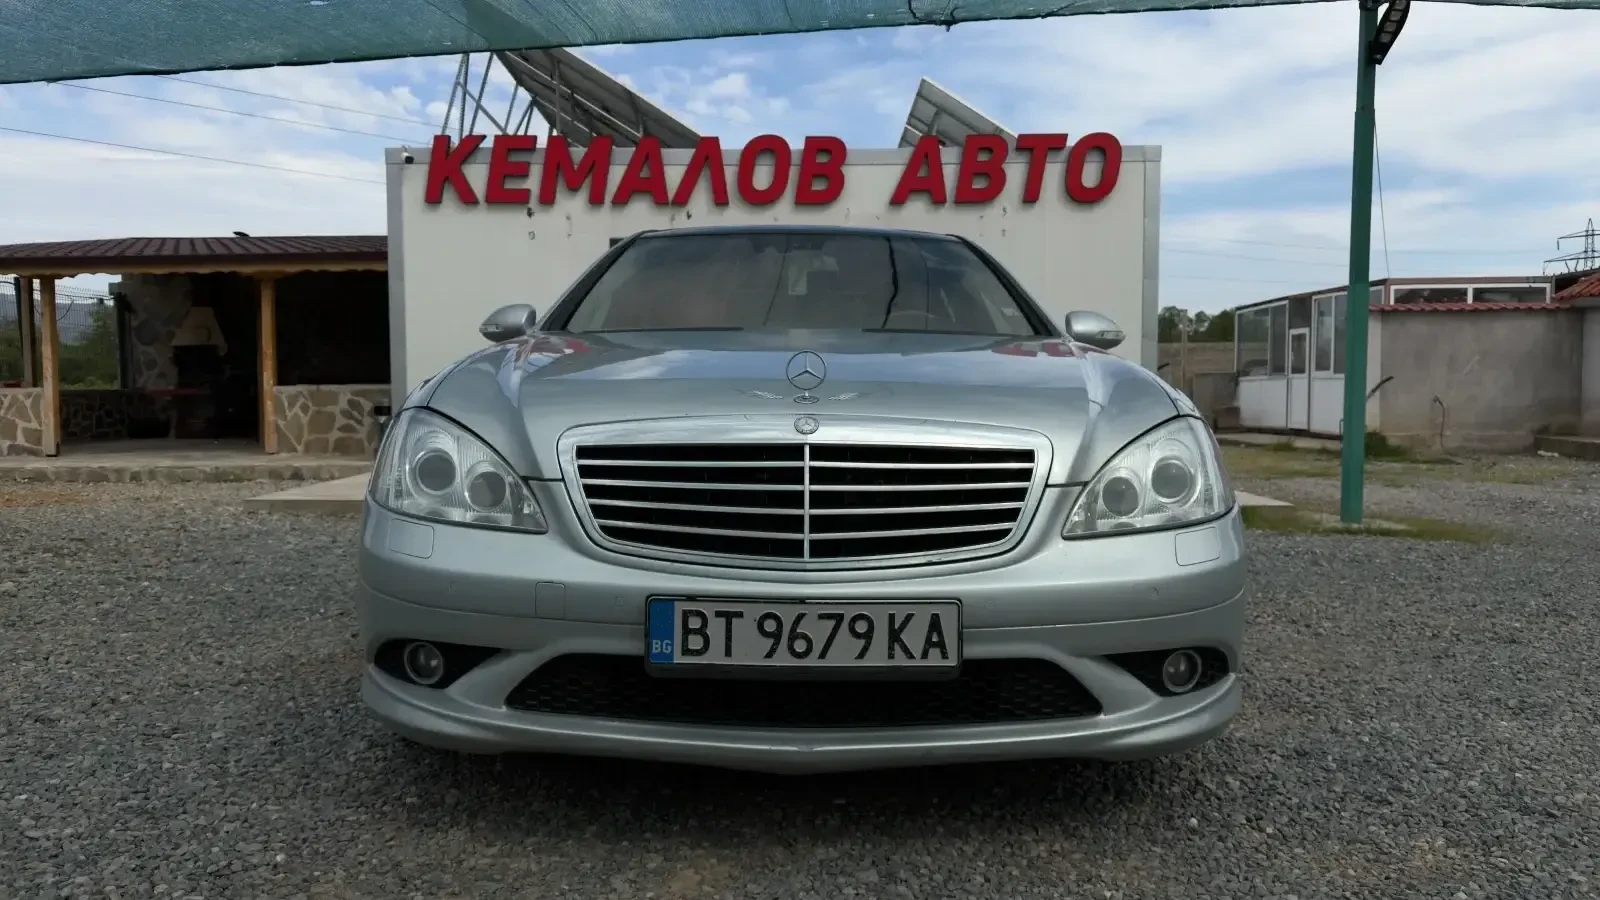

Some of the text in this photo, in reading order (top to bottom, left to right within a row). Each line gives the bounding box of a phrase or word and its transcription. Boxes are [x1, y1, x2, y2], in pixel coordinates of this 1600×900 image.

[425, 132, 1122, 206] КЕМАЛОВ АВТО
[651, 639, 672, 654] BG
[681, 608, 950, 660] BT 9679 KA
